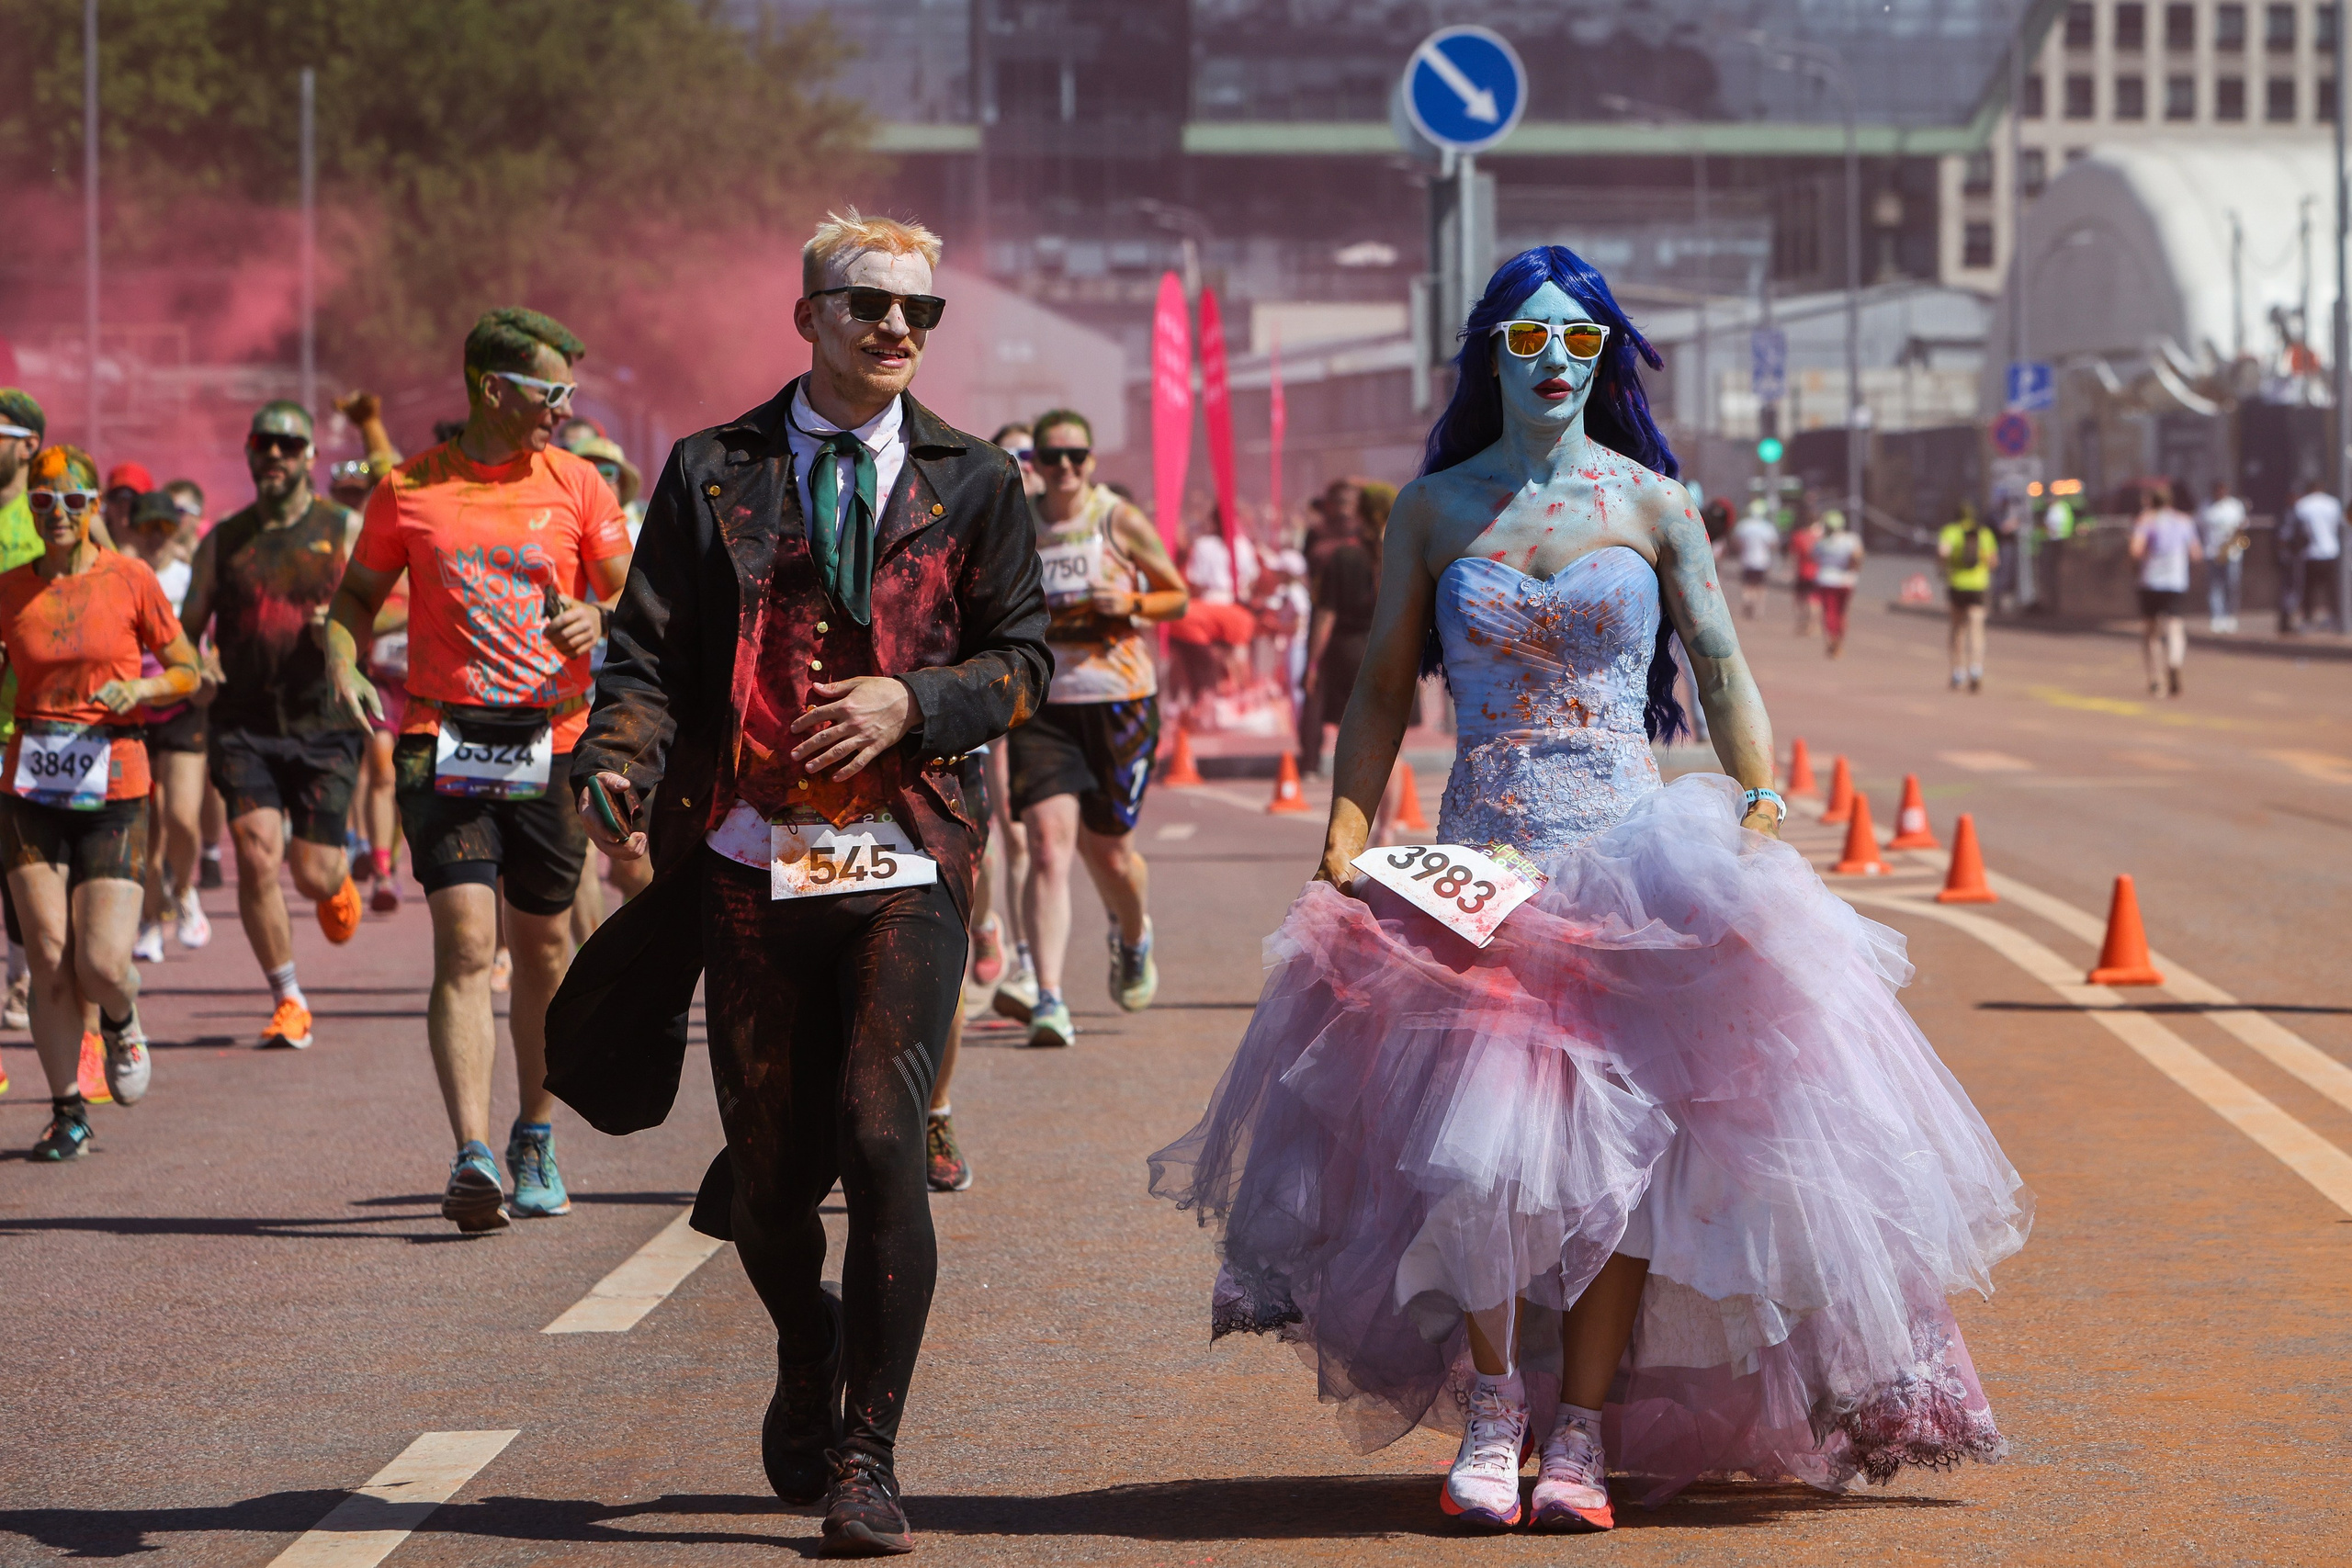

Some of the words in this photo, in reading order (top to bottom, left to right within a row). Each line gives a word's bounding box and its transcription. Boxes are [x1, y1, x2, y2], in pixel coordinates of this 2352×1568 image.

[455, 543, 543, 574] МОС
[461, 572, 531, 602] КОВ
[471, 628, 553, 658] ПОЛ
[483, 680, 559, 706] ФОН
[29, 750, 94, 778] 3849
[809, 844, 898, 885] 545
[1387, 846, 1497, 914] 3983
